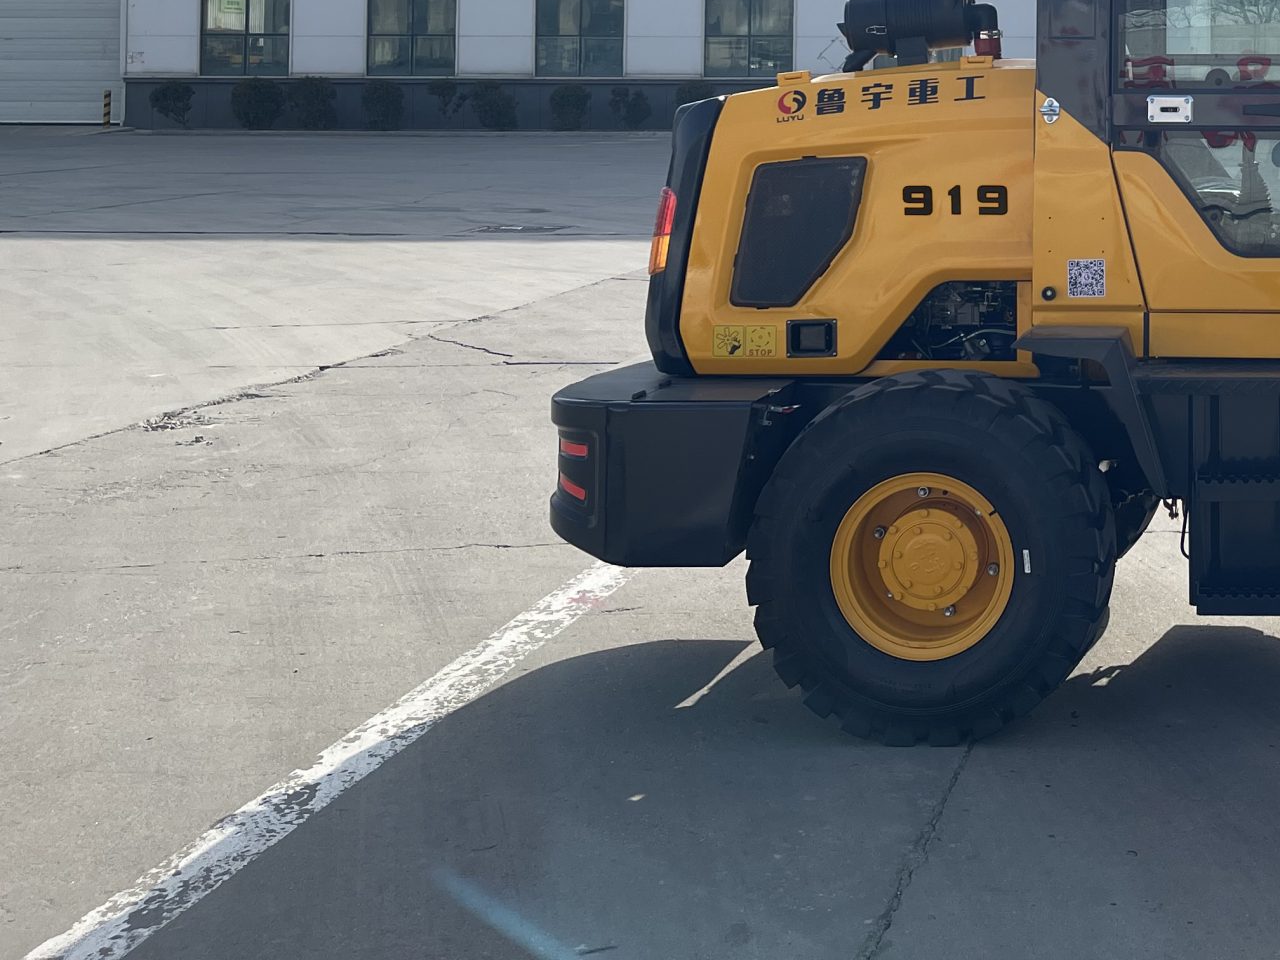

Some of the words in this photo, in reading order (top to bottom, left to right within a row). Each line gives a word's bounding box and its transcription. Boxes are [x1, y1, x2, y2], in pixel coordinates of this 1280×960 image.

[814, 75, 986, 116] 鲁宇重工
[776, 114, 805, 123] LUYU
[902, 184, 1009, 216] 919
[748, 348, 773, 357] STOP
